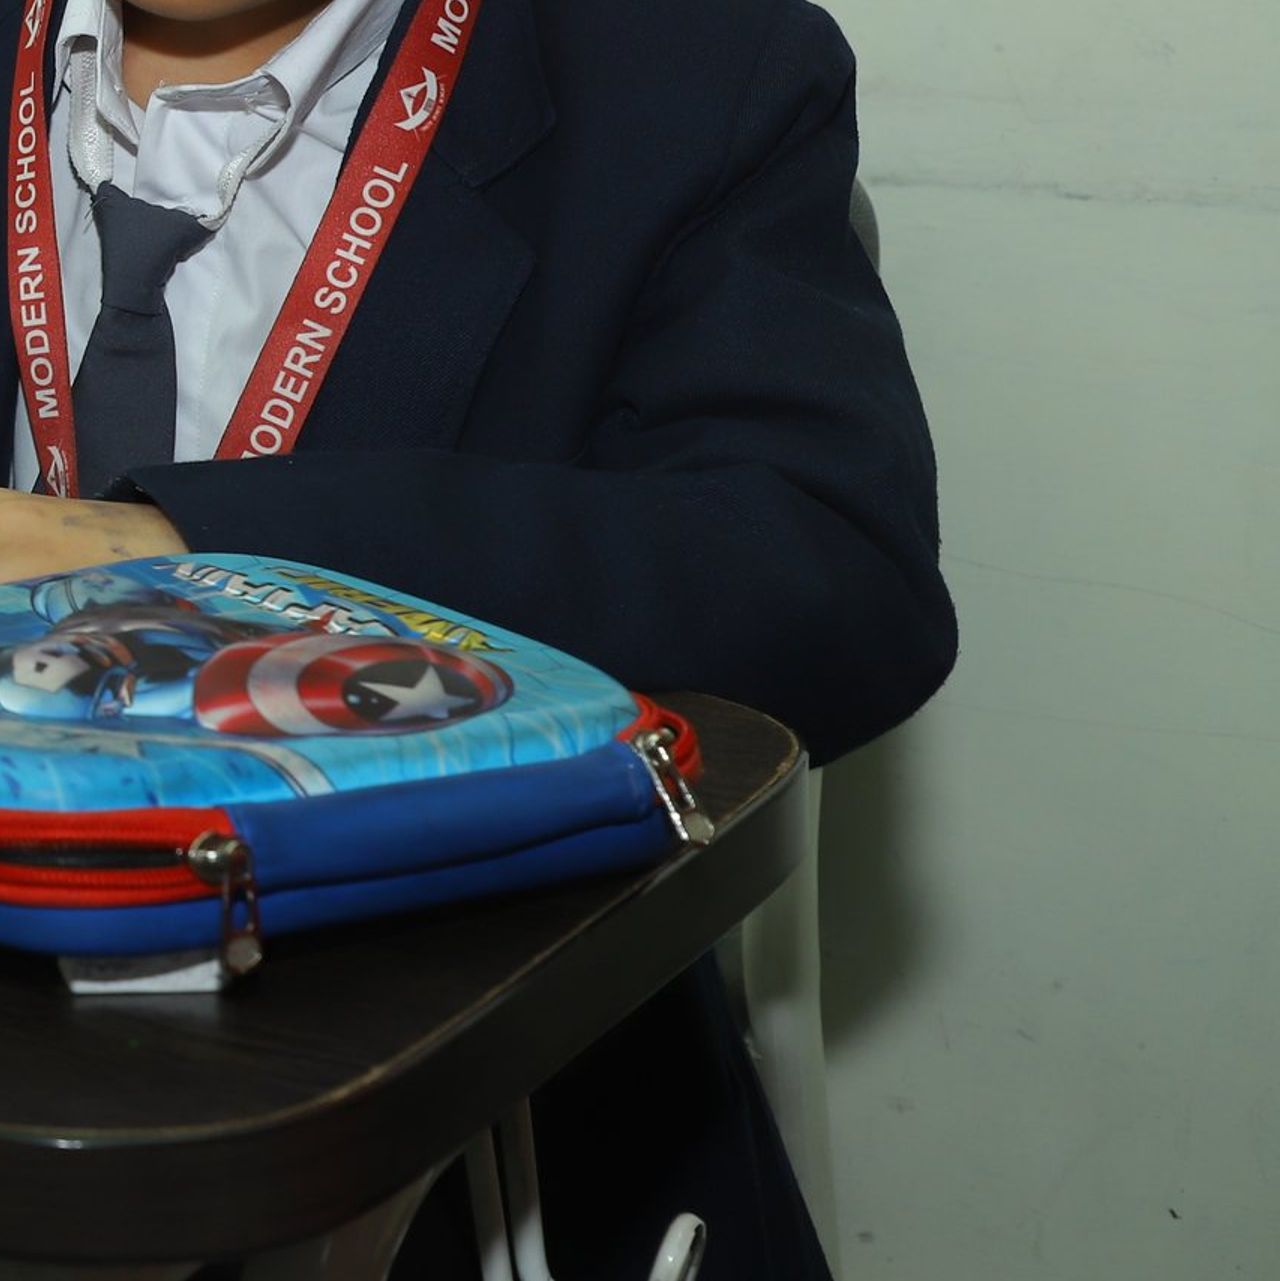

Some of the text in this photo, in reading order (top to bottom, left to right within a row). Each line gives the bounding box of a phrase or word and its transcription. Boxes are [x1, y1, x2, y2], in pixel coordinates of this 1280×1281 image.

[12, 70, 60, 419] MODERN SCHOOL
[314, 160, 409, 316] SCHOOL
